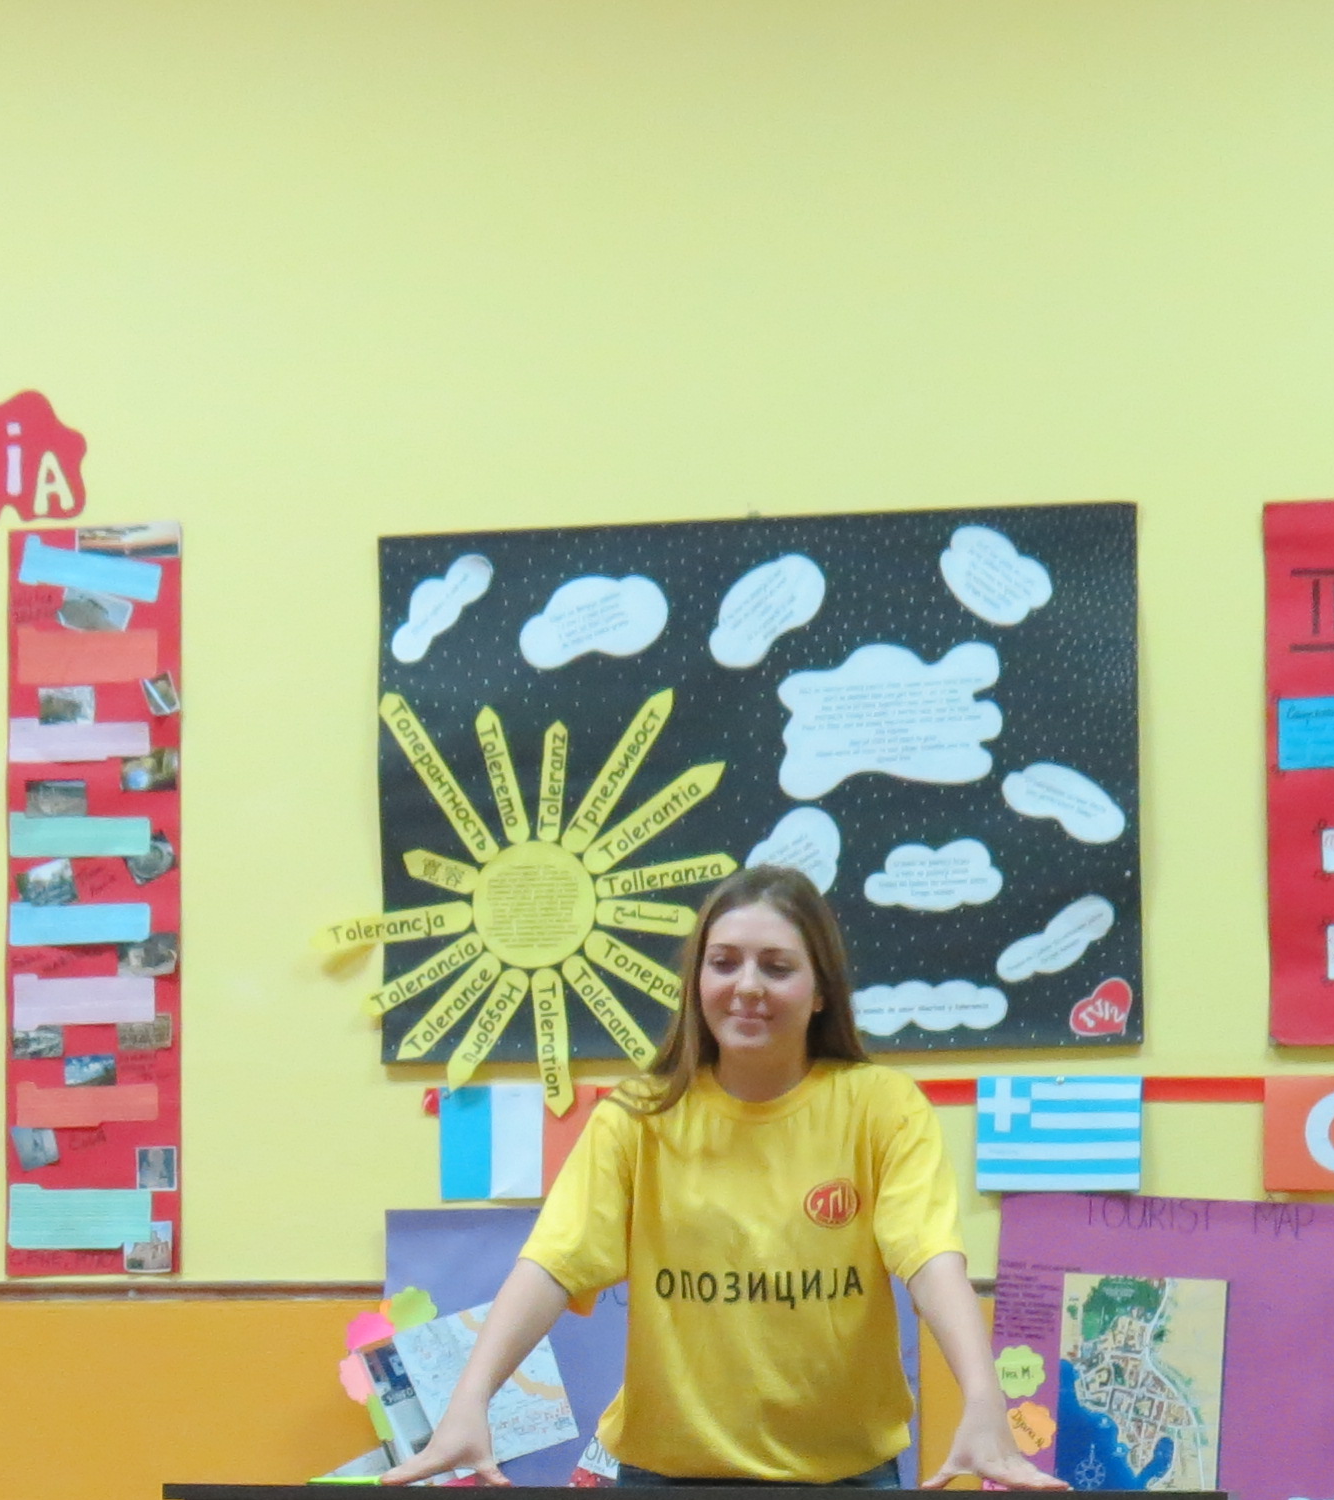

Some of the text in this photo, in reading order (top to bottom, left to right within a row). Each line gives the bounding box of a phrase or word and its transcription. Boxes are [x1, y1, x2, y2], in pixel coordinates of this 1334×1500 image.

[389, 698, 488, 853] Толерантность
[539, 732, 567, 832] Toleranz
[568, 708, 663, 835] Трпељивост
[598, 782, 703, 863] Tolerantia
[604, 861, 724, 897] Tolleranza
[328, 909, 446, 945] Tolerancja
[404, 964, 495, 1055] Tolerance
[575, 965, 648, 1062] Tolérance
[603, 938, 680, 1011] Толера
[536, 980, 563, 1099] Toleration
[653, 1266, 866, 1311] ОПОЗИЦИЈА
